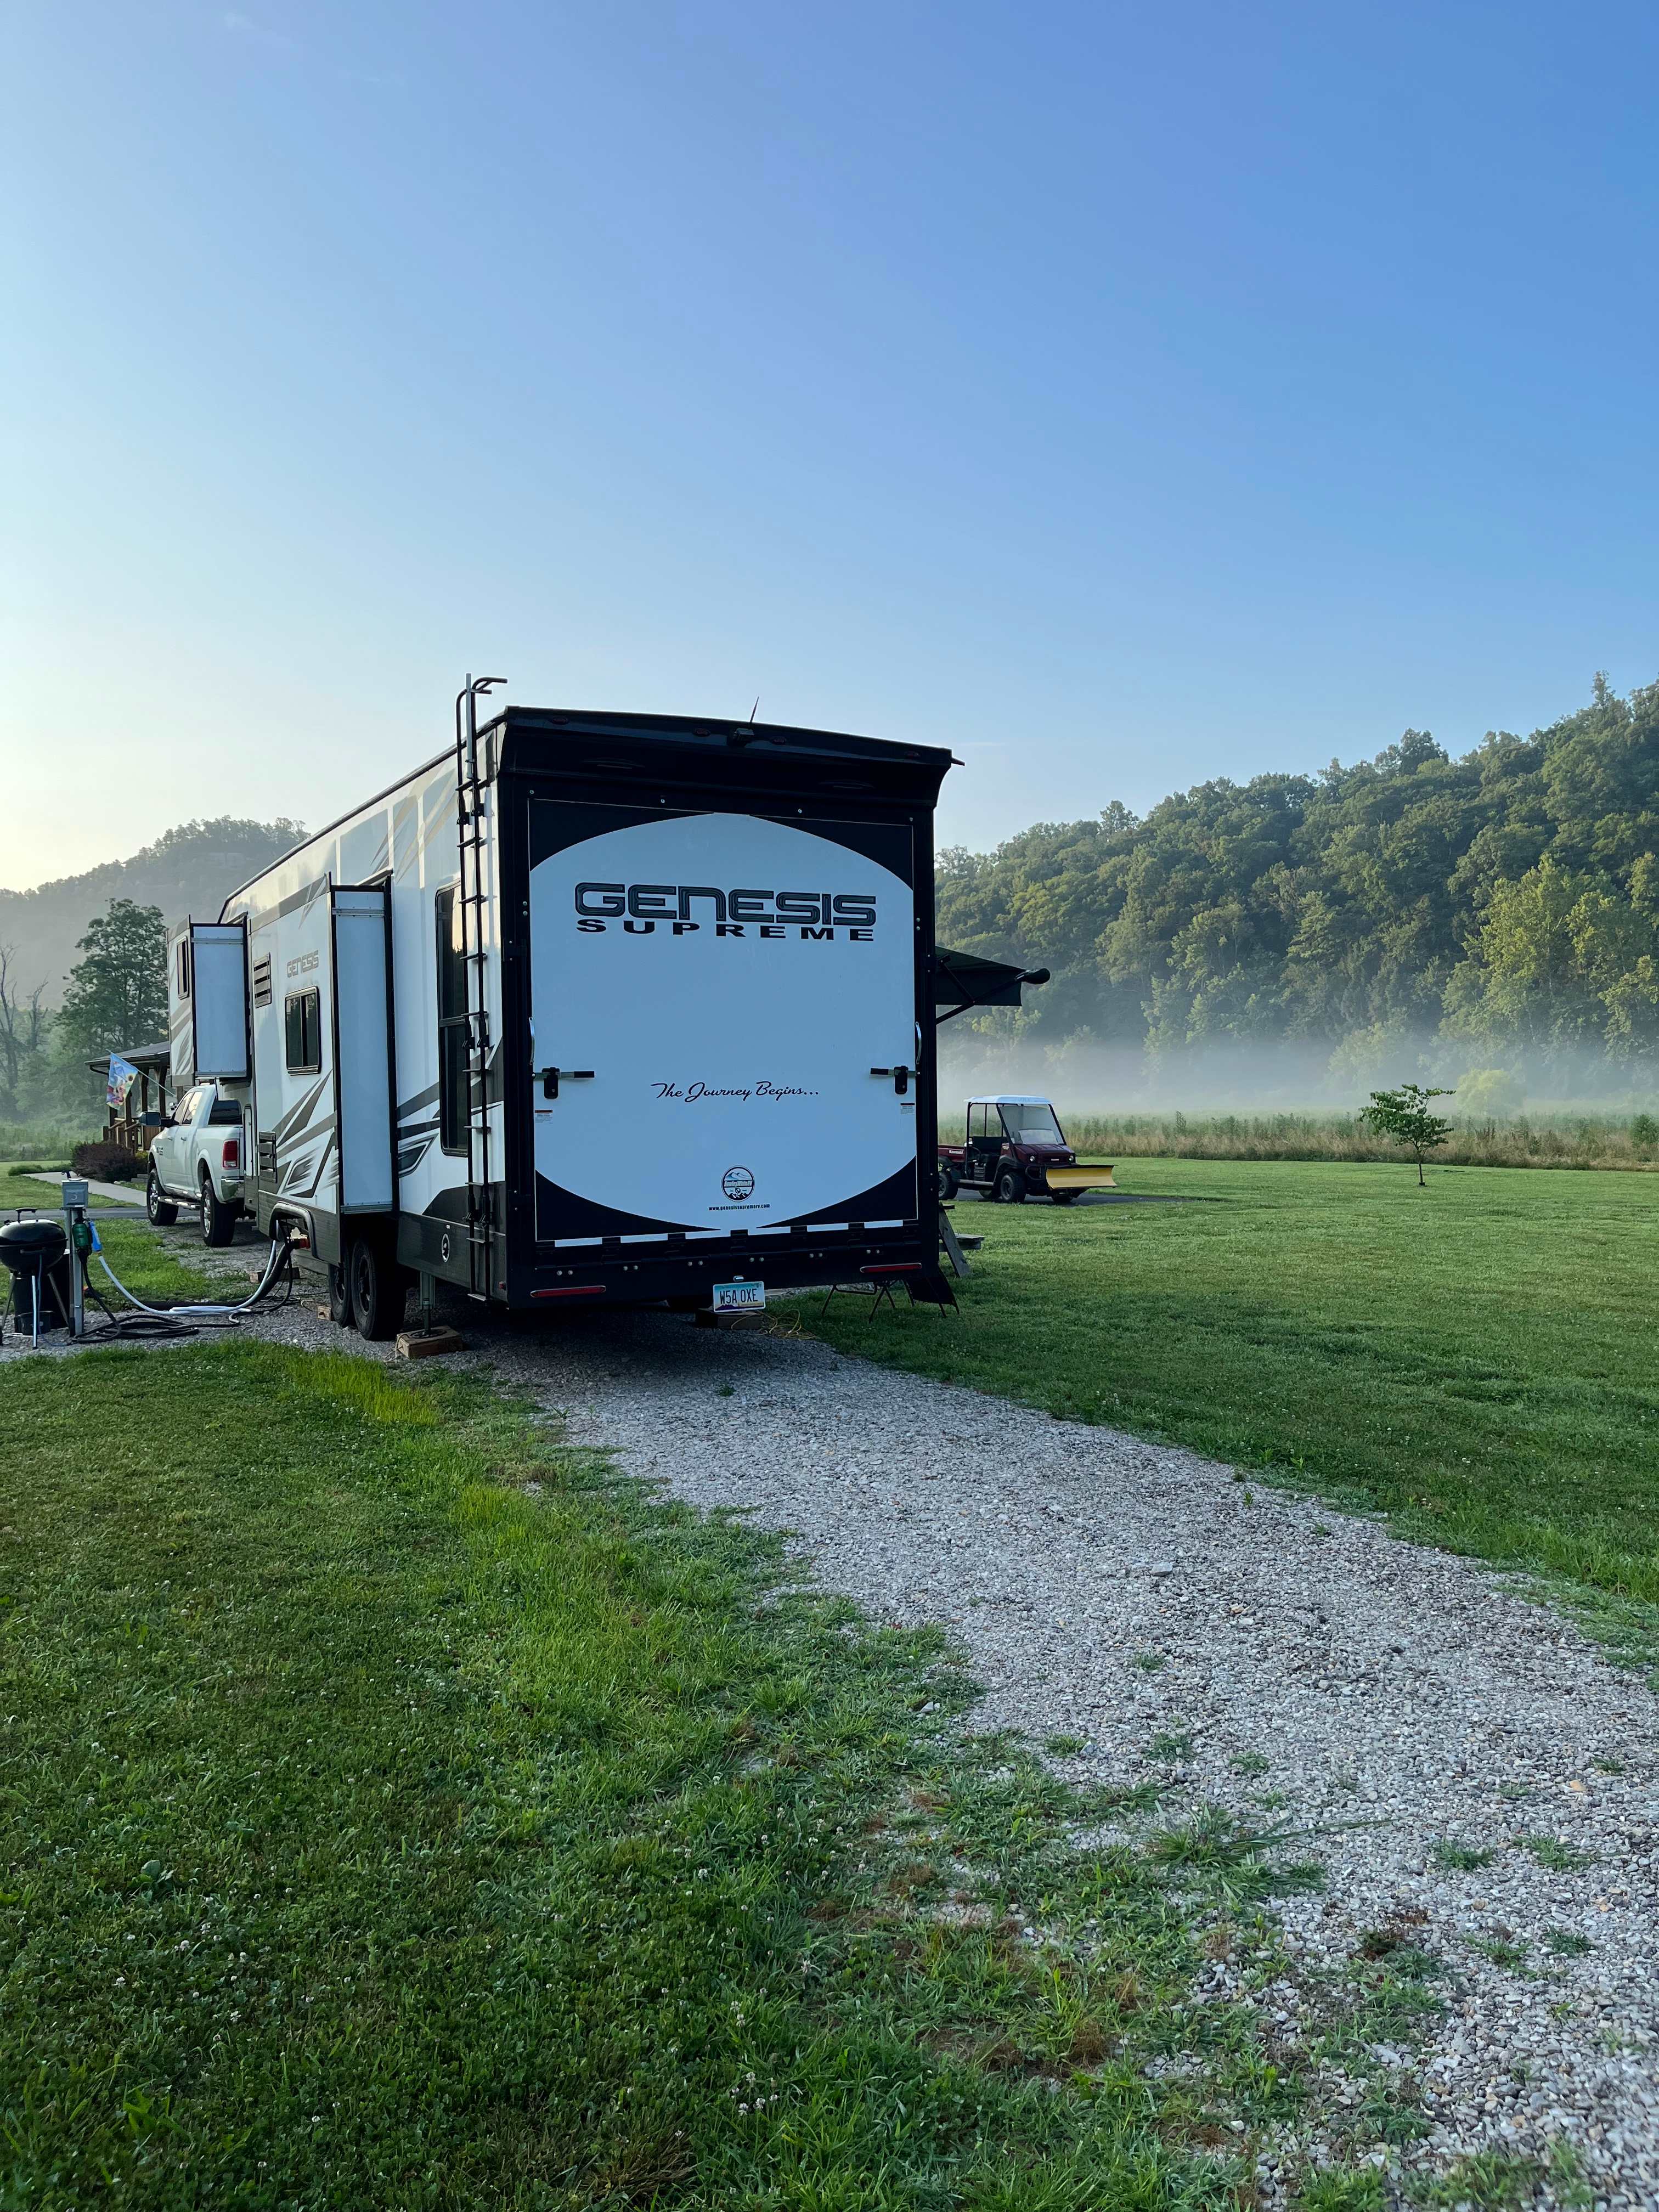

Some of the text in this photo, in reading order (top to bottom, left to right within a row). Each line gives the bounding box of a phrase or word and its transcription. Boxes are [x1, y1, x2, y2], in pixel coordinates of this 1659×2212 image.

[575, 882, 876, 927] GENESIS
[576, 918, 874, 941] SUPREME
[287, 950, 319, 978] GENESIS
[651, 1081, 819, 1103] The Journey Begins...
[719, 1290, 737, 1304] W5A
